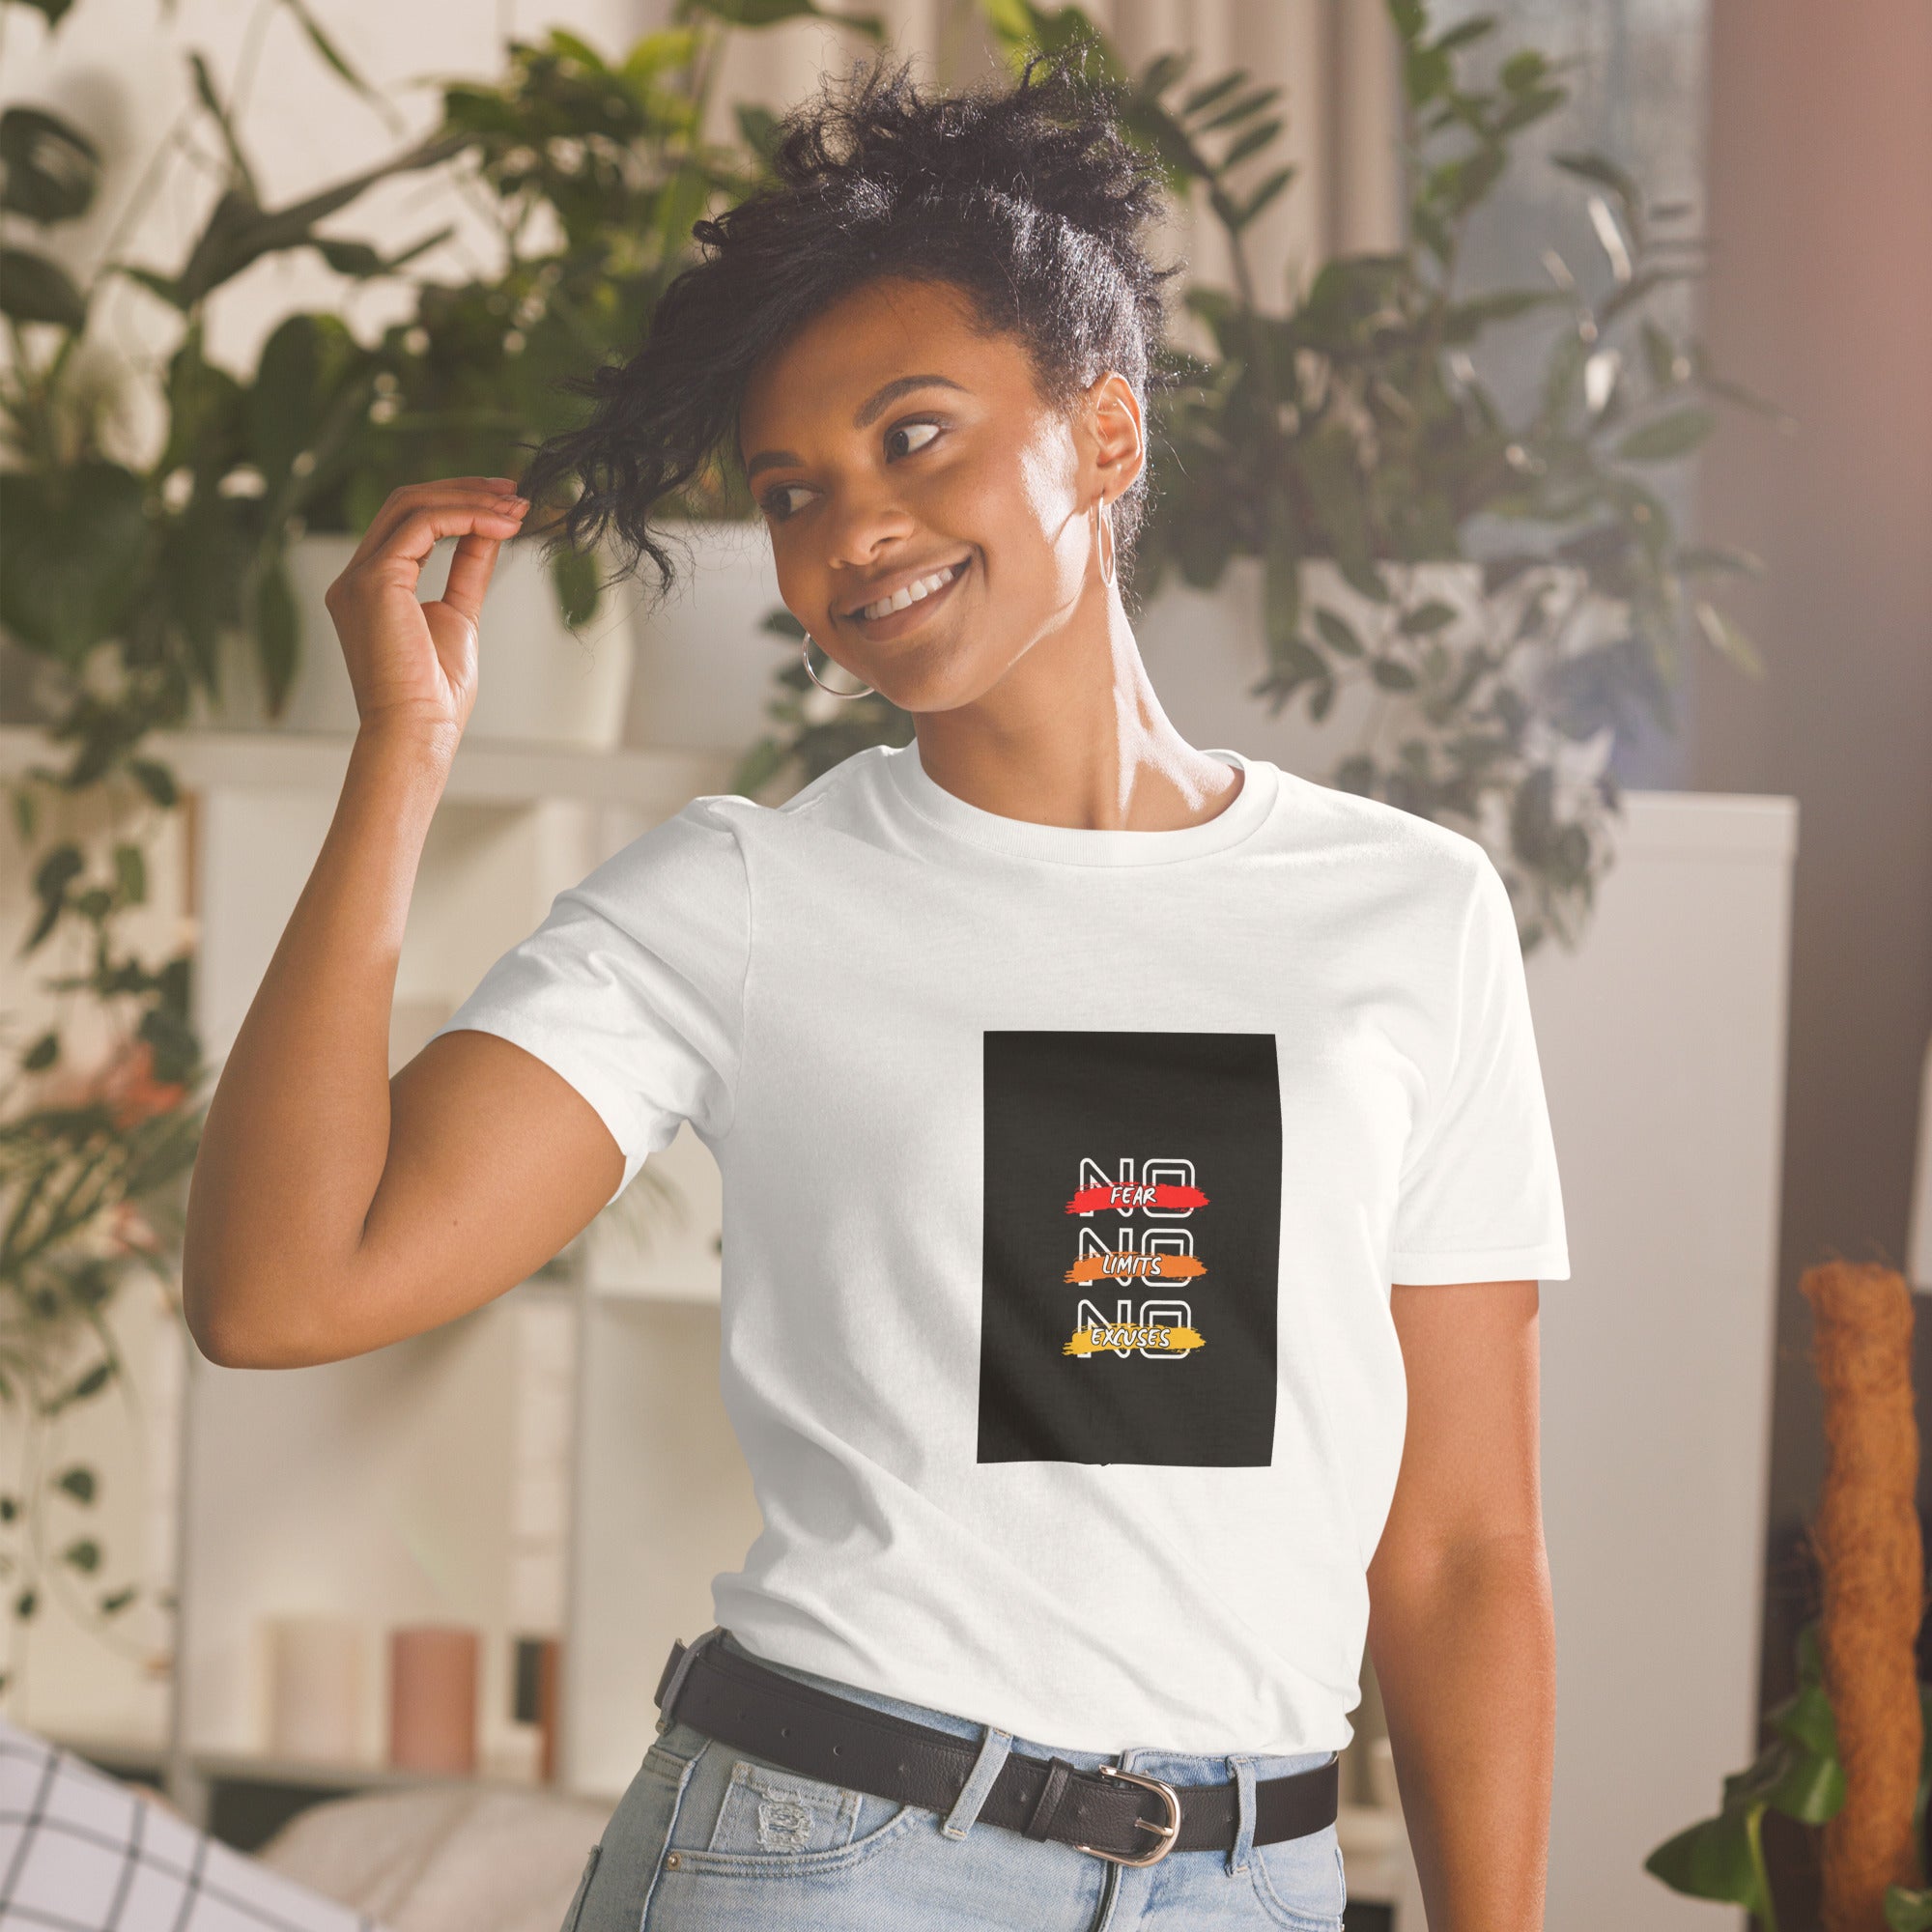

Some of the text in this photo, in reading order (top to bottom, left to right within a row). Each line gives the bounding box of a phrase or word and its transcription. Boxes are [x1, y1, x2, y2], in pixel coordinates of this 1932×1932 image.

[1079, 1157, 1196, 1218] NO
[1110, 1185, 1157, 1207] FEAR
[1078, 1227, 1194, 1288] NO
[1101, 1254, 1163, 1275] LIMITS
[1077, 1298, 1192, 1359] NO
[1091, 1328, 1171, 1348] EXCUSES
